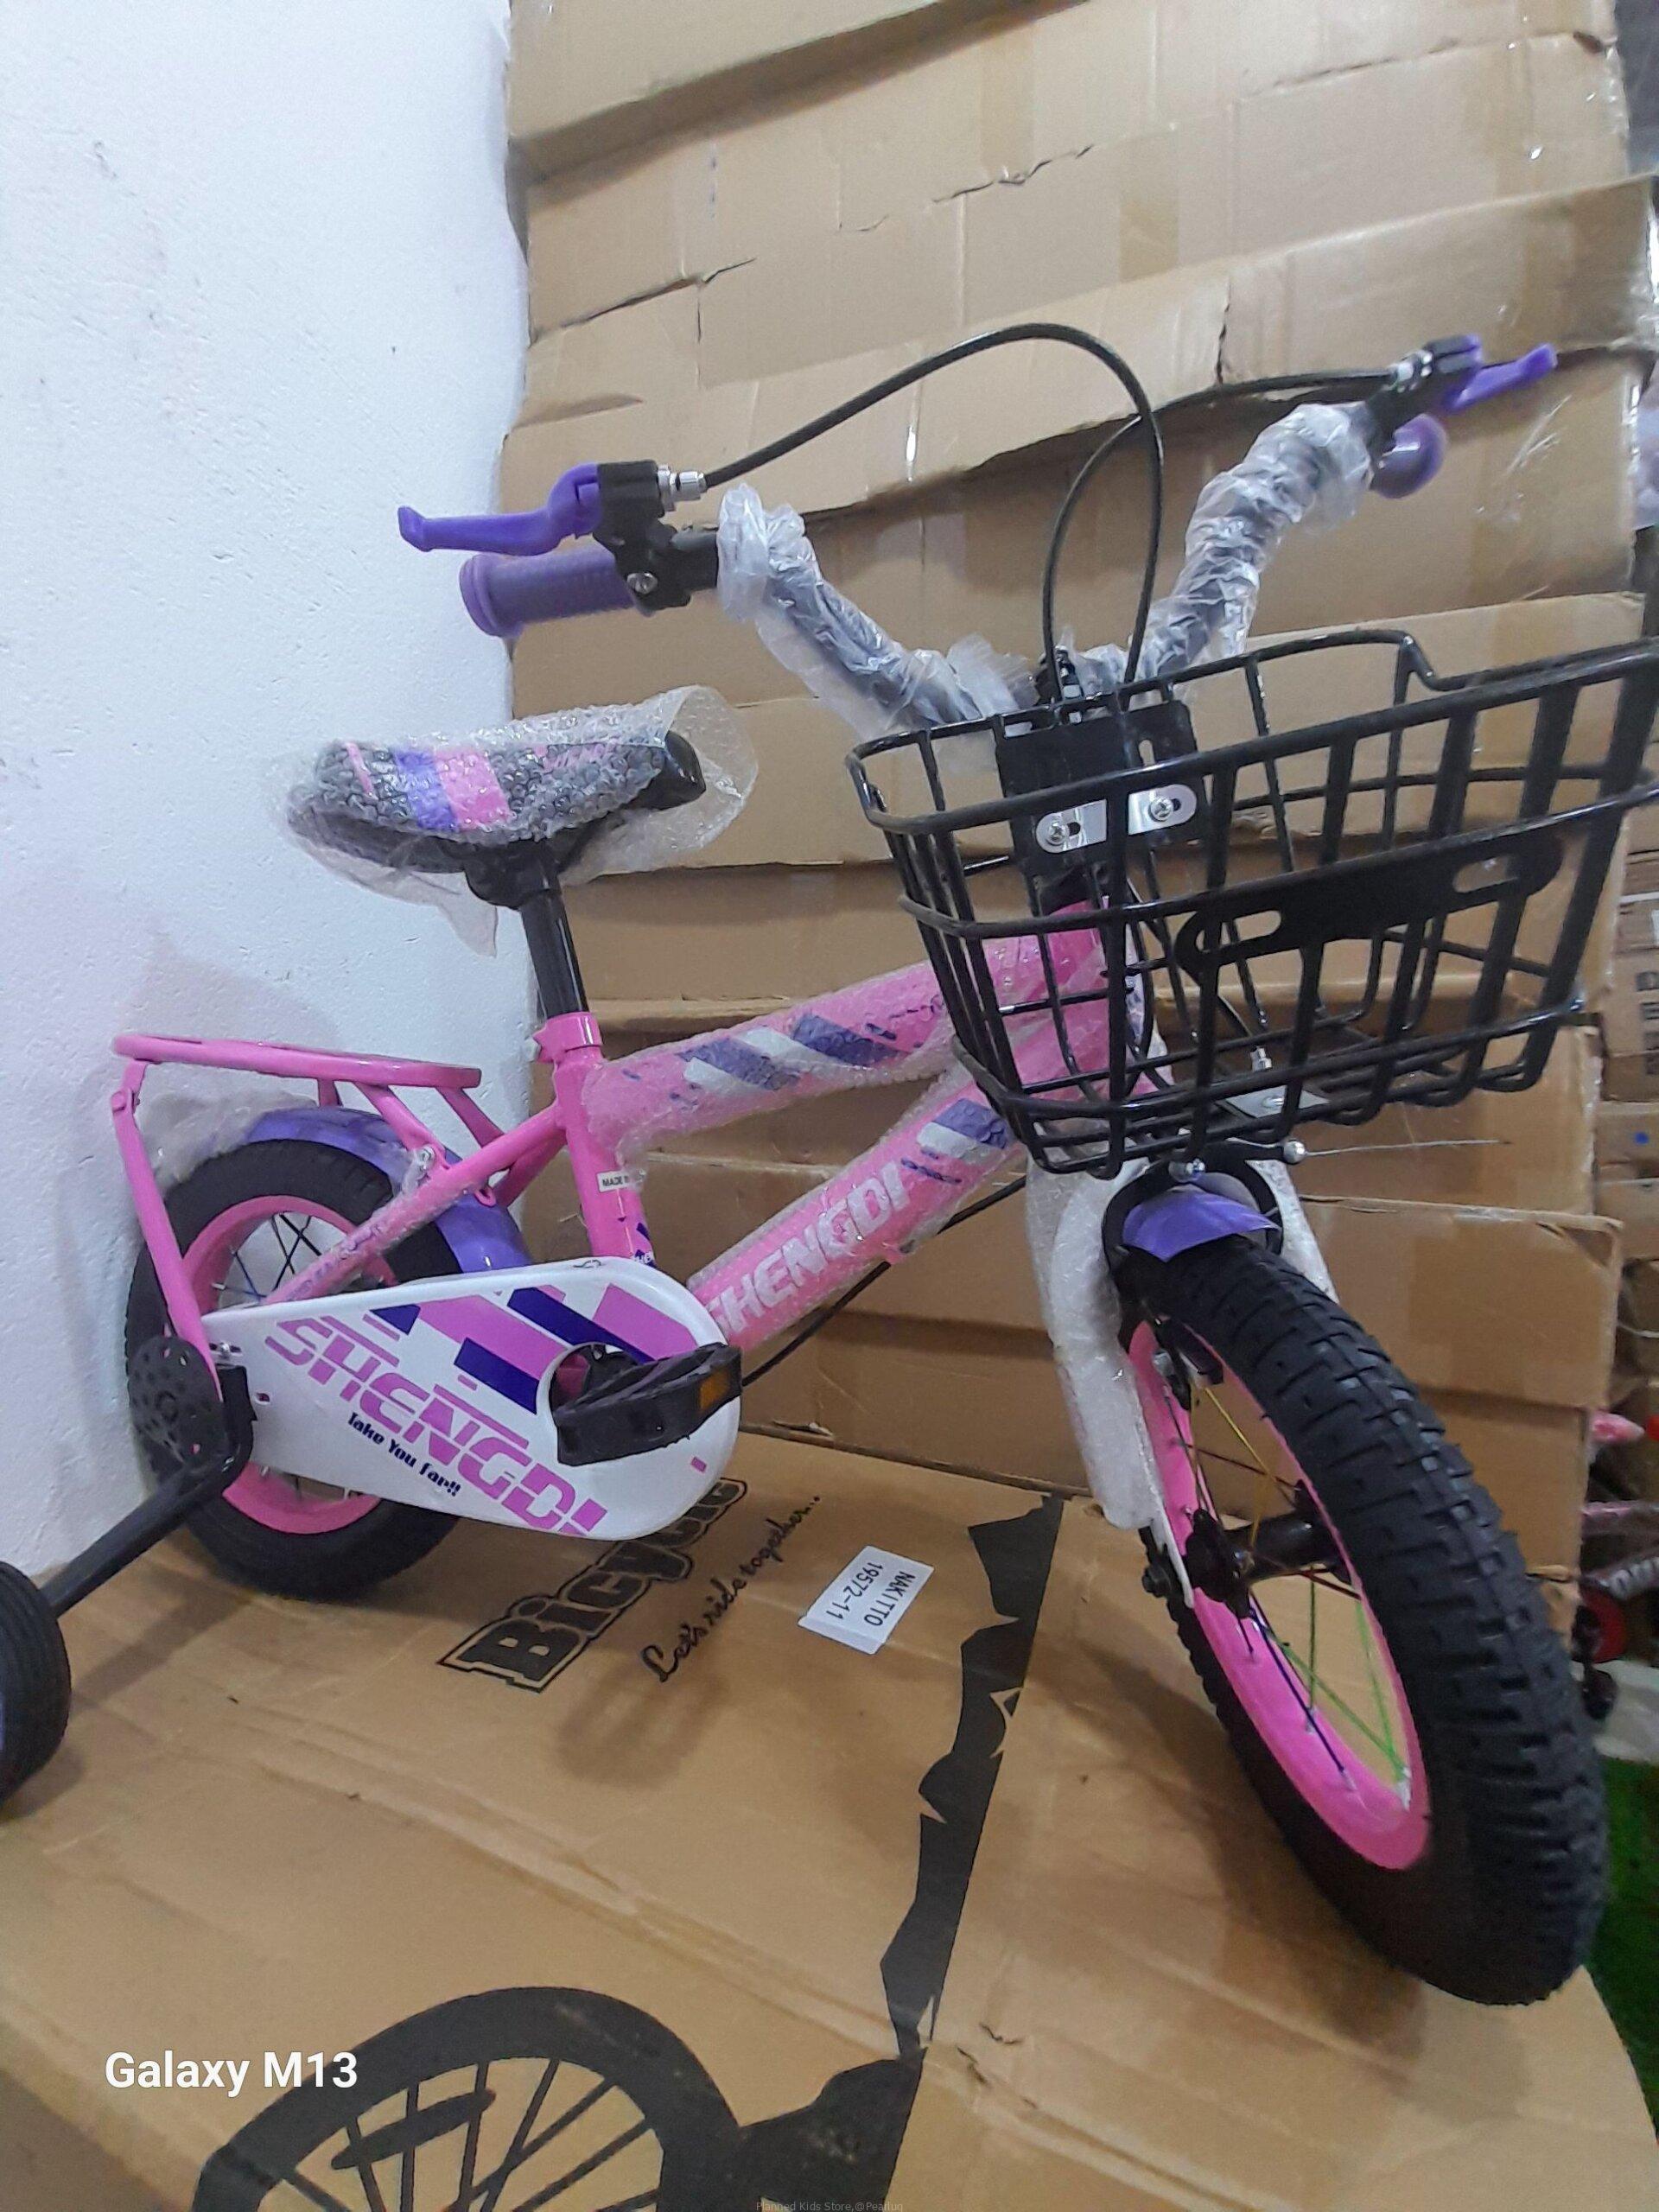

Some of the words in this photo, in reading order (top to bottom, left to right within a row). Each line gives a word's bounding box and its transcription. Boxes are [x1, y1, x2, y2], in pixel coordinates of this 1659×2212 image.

[264, 1315, 607, 1537] SHENGDI
[347, 1411, 385, 1445] Take
[388, 1438, 417, 1468] You
[825, 1561, 885, 1621] 19572-11
[863, 1570, 917, 1627] NAKITTO
